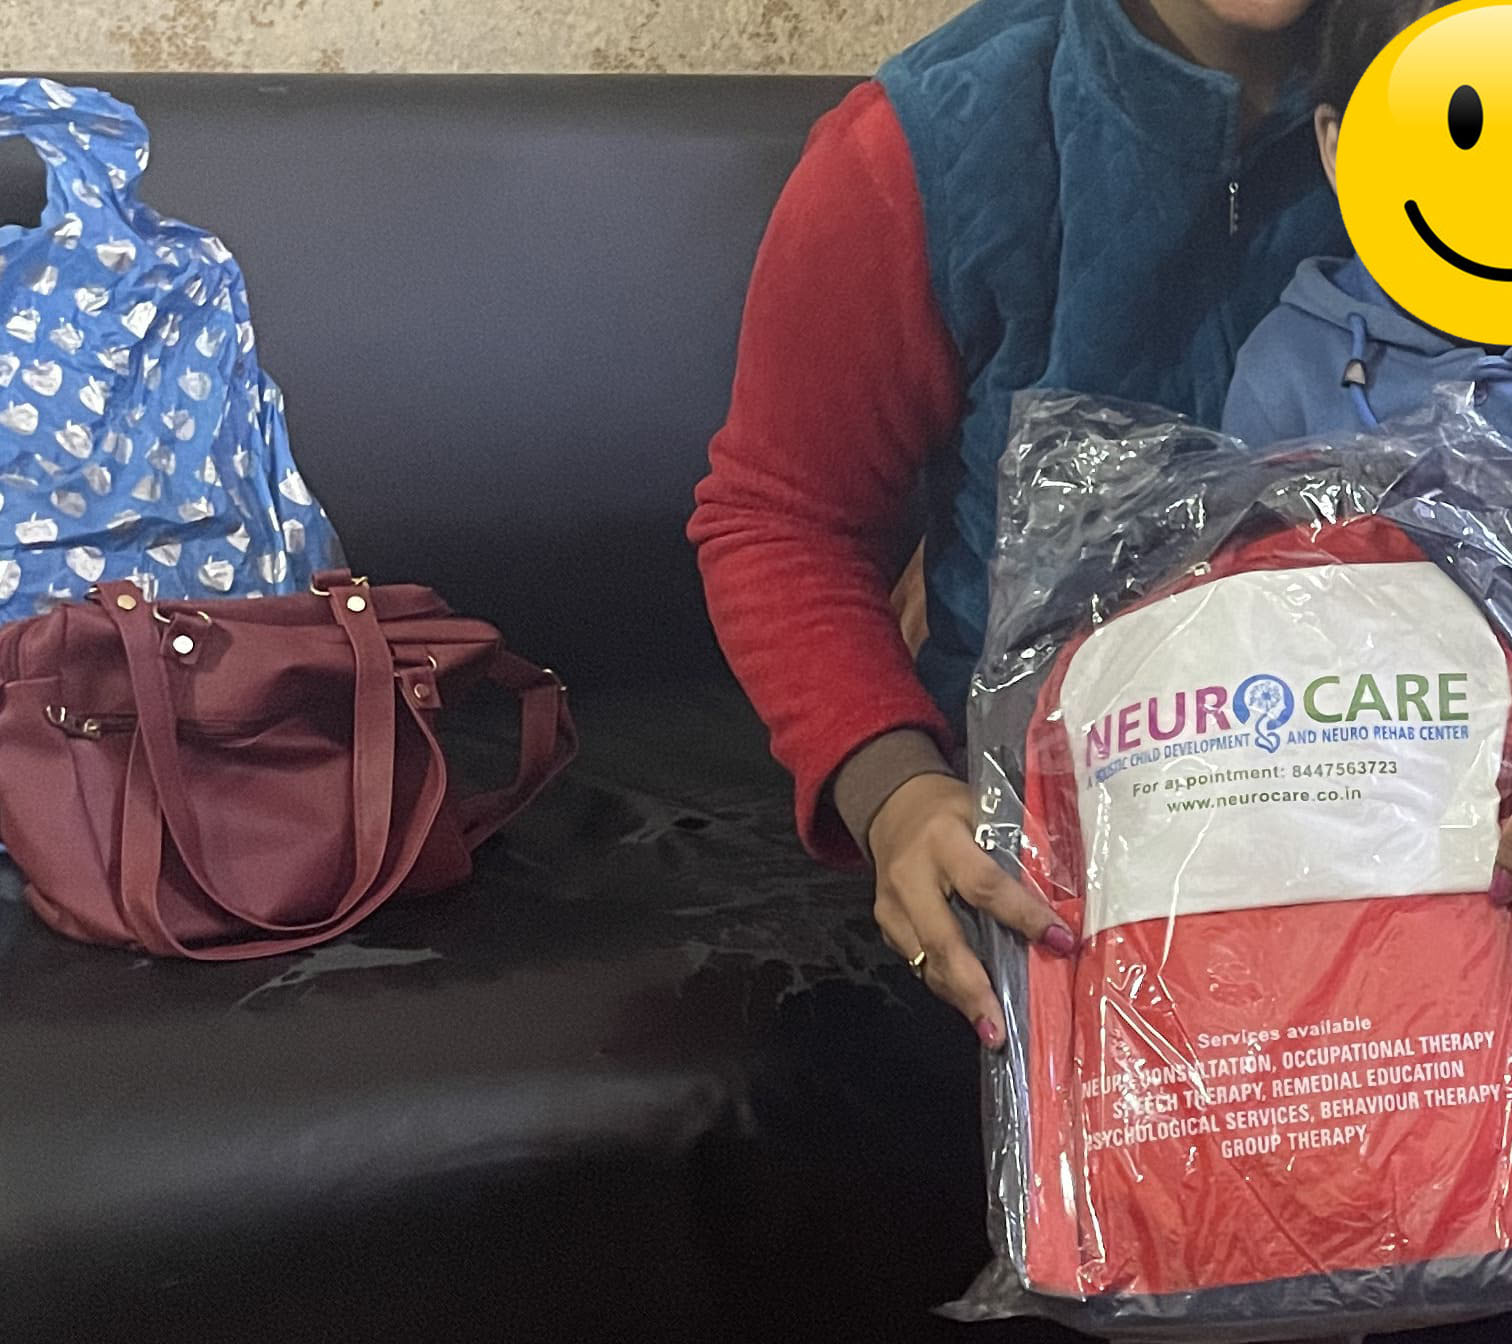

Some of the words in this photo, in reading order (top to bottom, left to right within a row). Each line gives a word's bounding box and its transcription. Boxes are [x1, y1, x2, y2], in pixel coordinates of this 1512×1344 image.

[1130, 747, 1160, 767] CHILD
[1164, 733, 1251, 759] DEVELOPMENT
[1287, 730, 1317, 744] AND
[1322, 727, 1369, 743] NEURO
[1374, 725, 1415, 741] REHAB
[1419, 725, 1469, 740] CENTER
[1133, 781, 1158, 797] For
[1292, 760, 1397, 778] 8447563723
[1167, 787, 1362, 813] www.neurocare.co.in
[1198, 1029, 1280, 1049] Services
[1287, 1016, 1372, 1039] available
[1282, 1038, 1415, 1069] OCCUPATIONAL
[1419, 1031, 1495, 1054] THERAPY
[1273, 1071, 1362, 1098] REMEDIAL
[1367, 1060, 1464, 1087] EDUCATION
[1226, 1103, 1316, 1131] SERVICES,
[1320, 1091, 1420, 1120] BEHAVIOUR
[1424, 1084, 1500, 1108] THERAPY
[1221, 1134, 1281, 1159] GROUP
[1287, 1124, 1367, 1151] THERAPY
